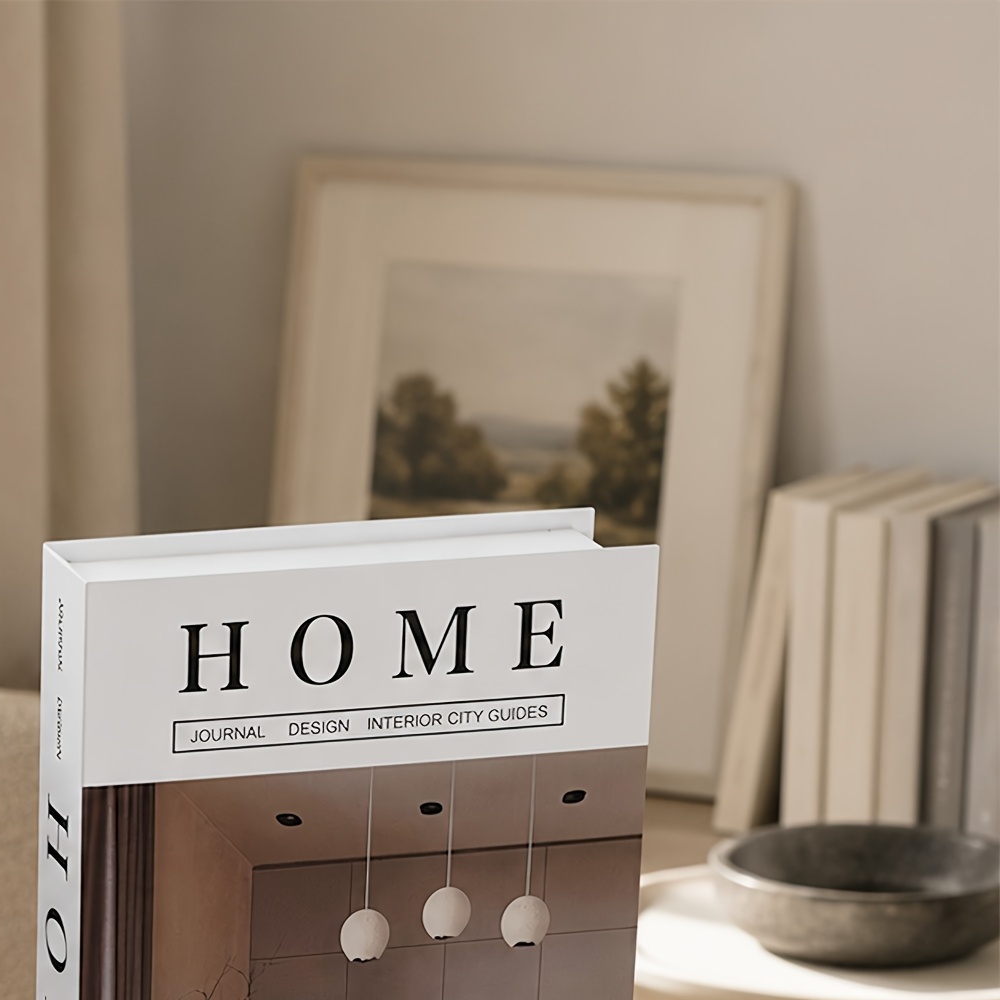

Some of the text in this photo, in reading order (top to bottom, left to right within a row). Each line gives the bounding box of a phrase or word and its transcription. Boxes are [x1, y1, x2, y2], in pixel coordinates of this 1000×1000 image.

[178, 599, 564, 694] HOME
[190, 705, 549, 744] JOURNAL DESIGN INTERIOR CITY GUIDES
